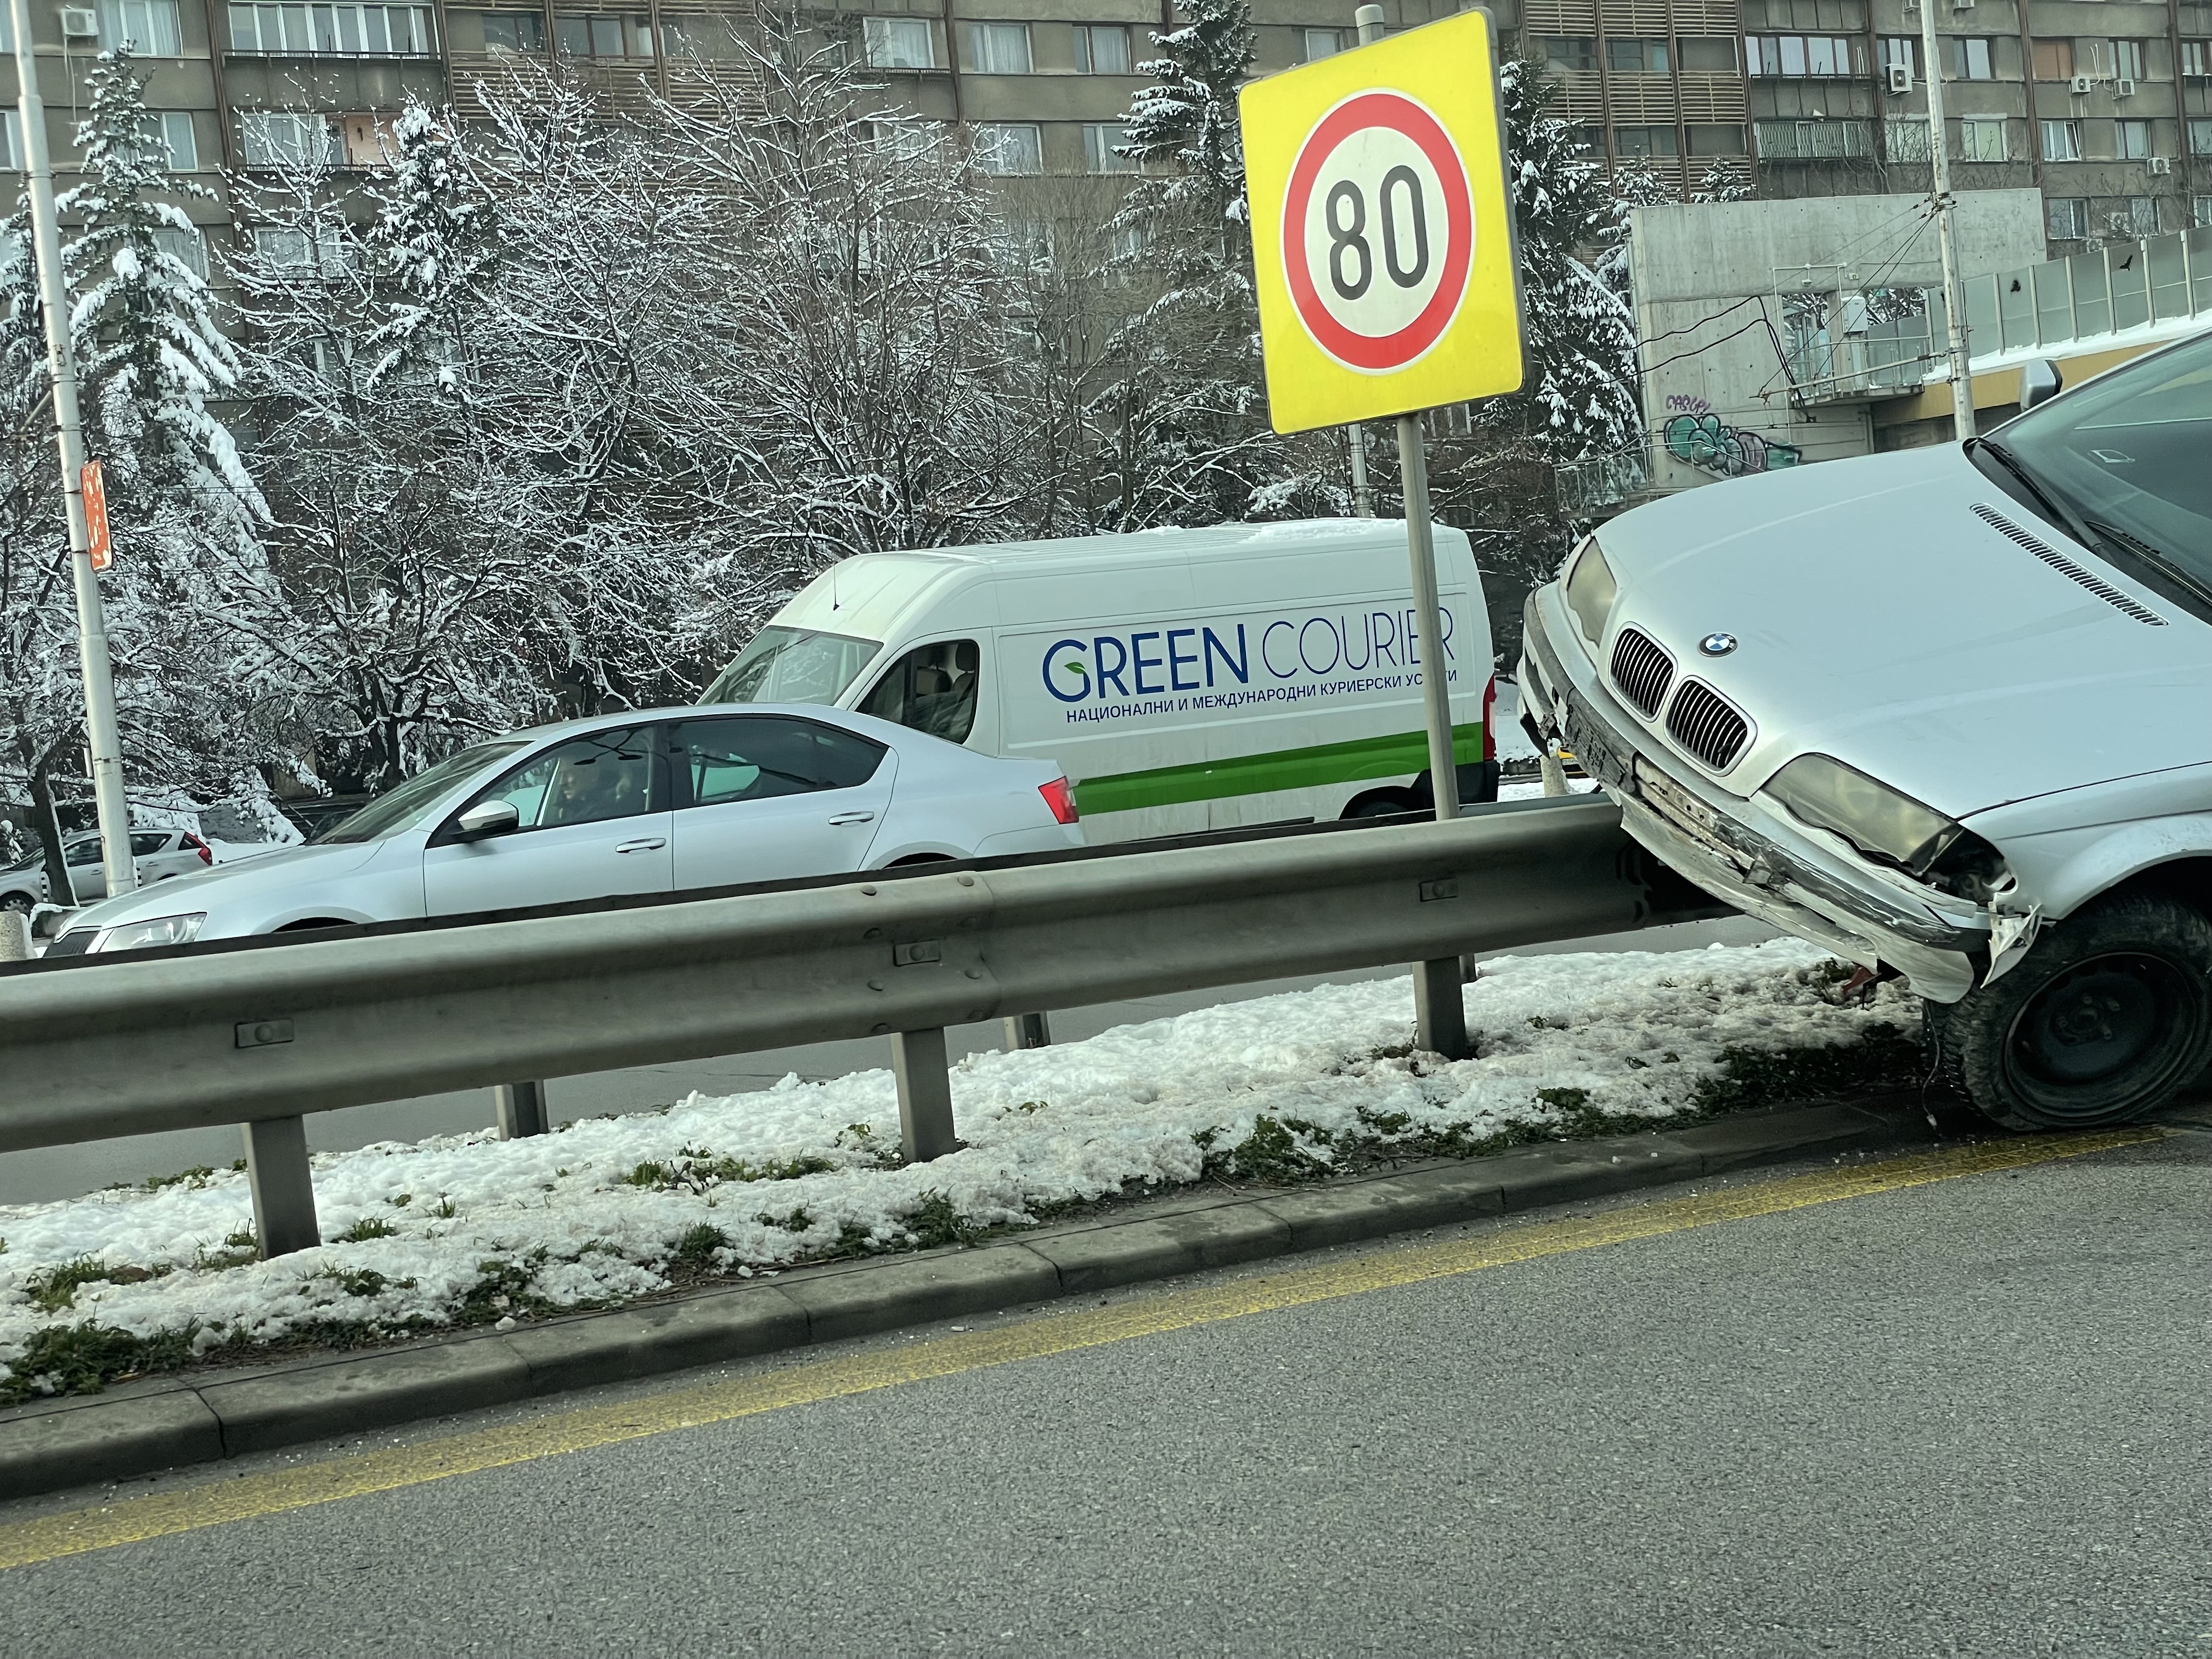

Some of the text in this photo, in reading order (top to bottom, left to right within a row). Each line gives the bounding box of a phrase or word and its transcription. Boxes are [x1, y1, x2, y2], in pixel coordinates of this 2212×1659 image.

[1326, 165, 1429, 300] 80
[1042, 607, 1455, 702] GREEN COURIER
[1067, 669, 1457, 723] НАЦИОНАЛНИ И МЕЖДУНАРОДНИ КУРИЕРСКИ УСИ
